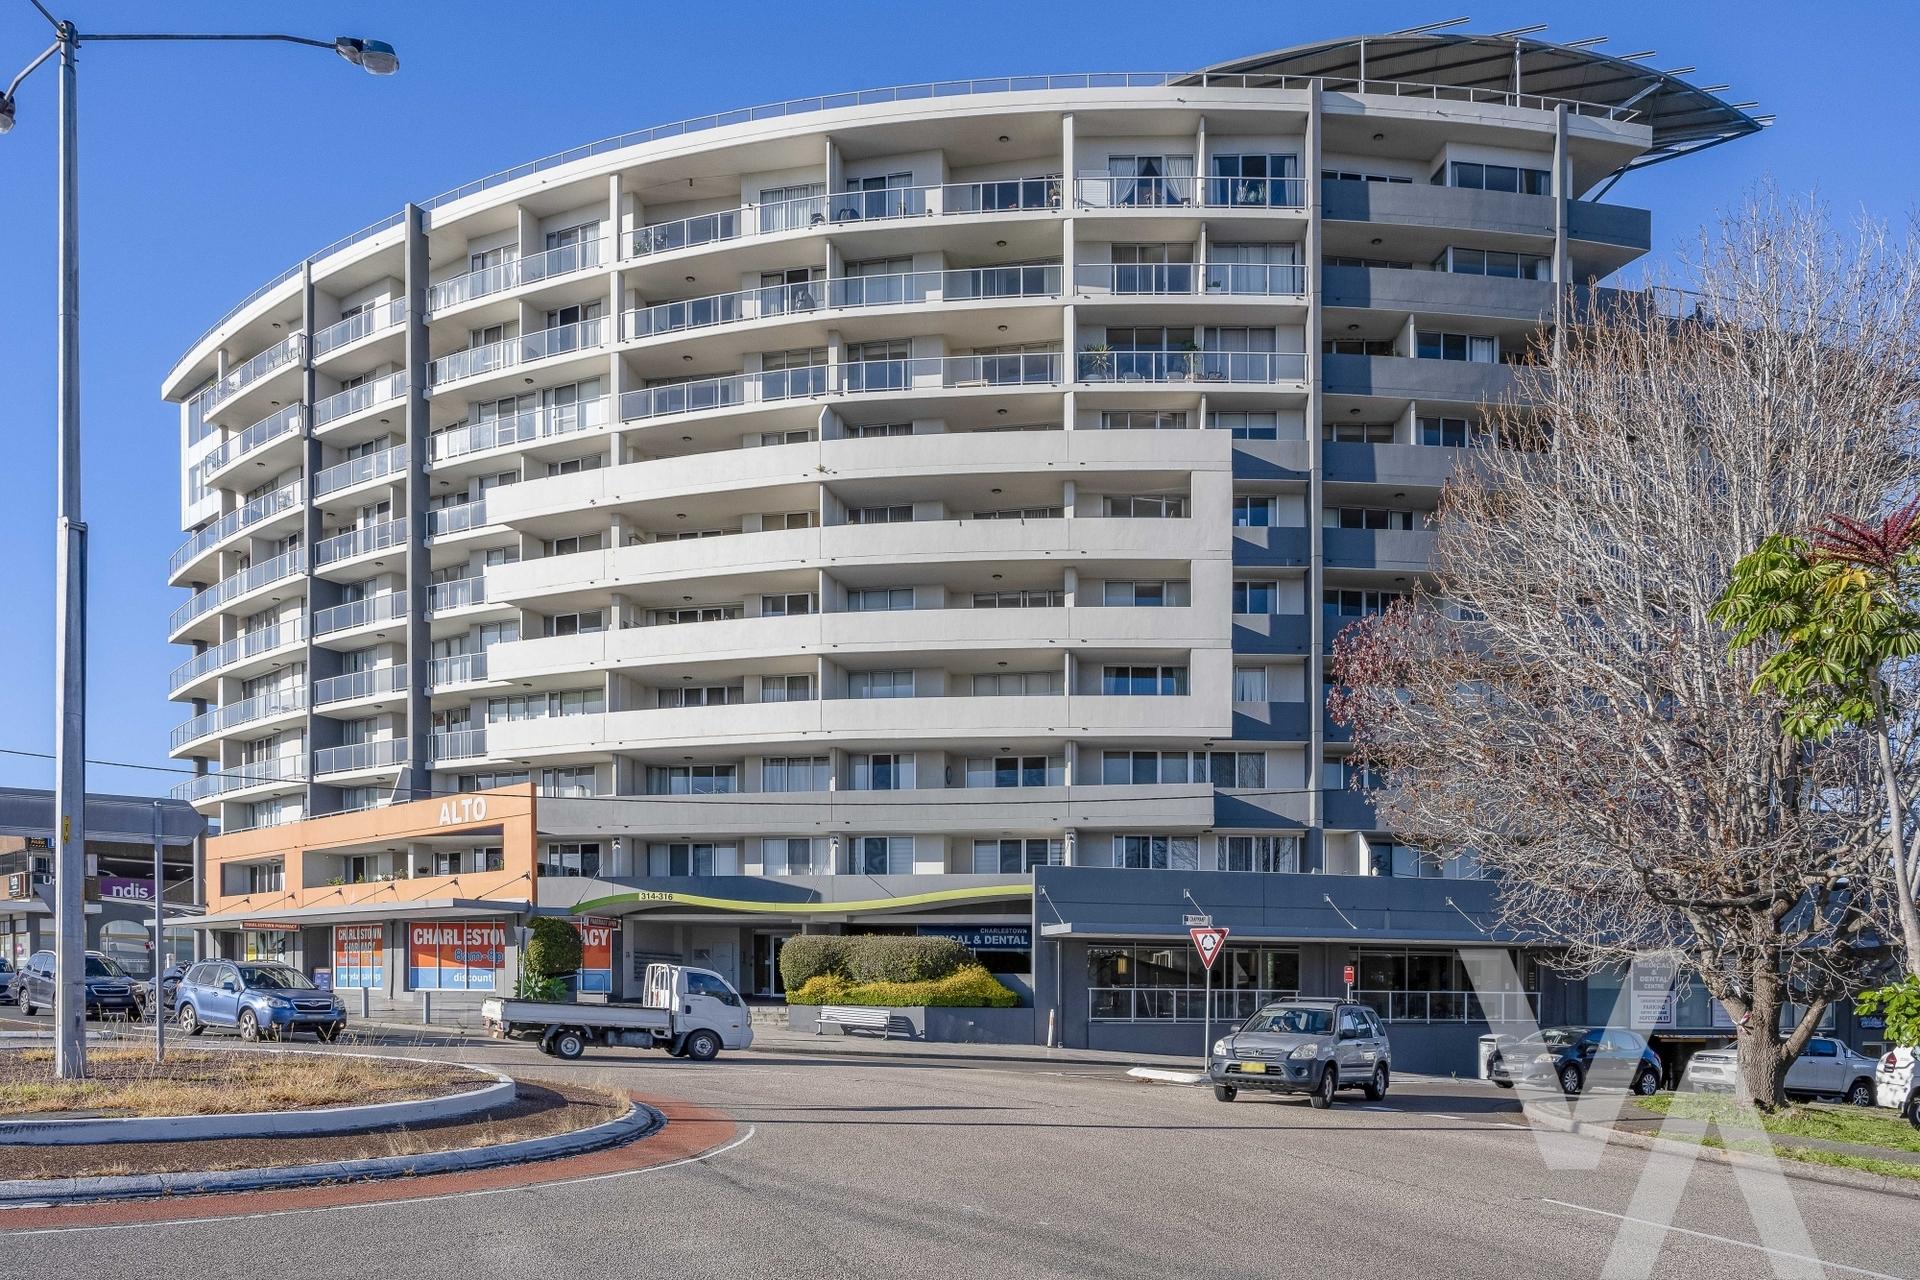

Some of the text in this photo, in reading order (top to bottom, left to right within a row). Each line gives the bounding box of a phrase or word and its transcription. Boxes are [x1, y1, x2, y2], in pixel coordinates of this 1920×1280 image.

[440, 797, 487, 826] ALTO
[112, 882, 149, 899] ndis
[640, 892, 673, 901] 314-316
[338, 927, 382, 941] CHRLSTOWN
[973, 935, 982, 945] &
[984, 935, 1028, 945] DENTAL
